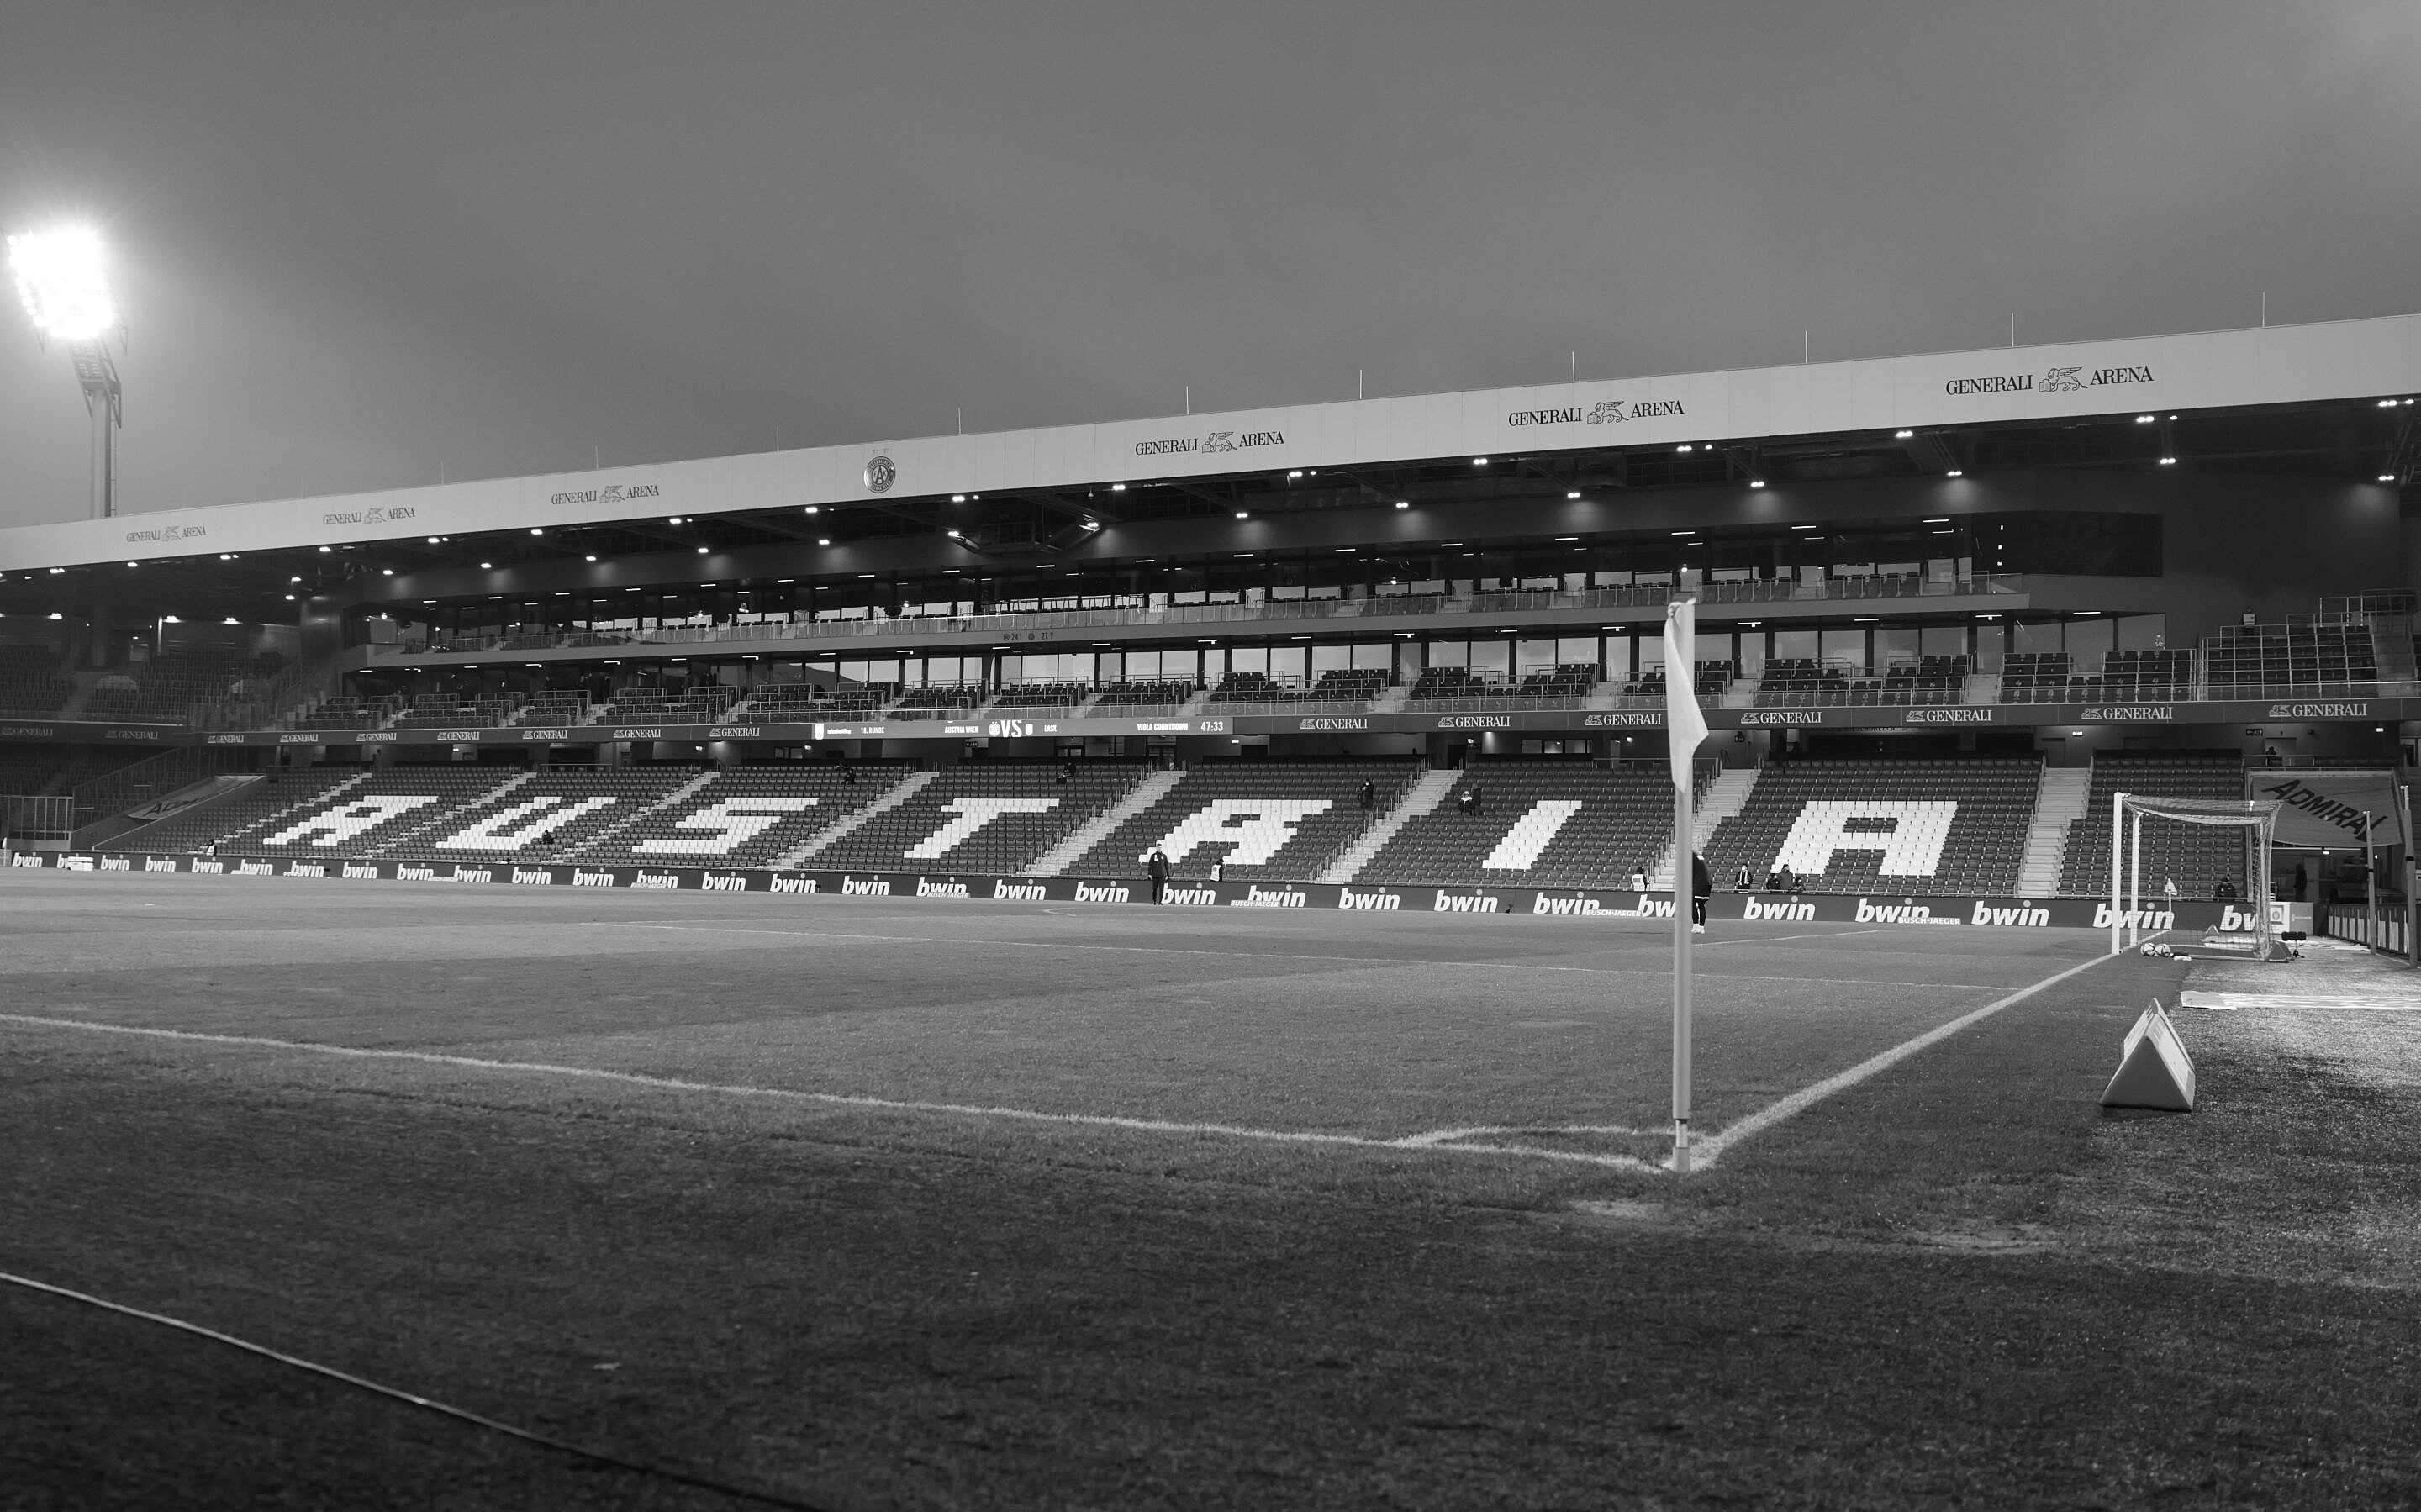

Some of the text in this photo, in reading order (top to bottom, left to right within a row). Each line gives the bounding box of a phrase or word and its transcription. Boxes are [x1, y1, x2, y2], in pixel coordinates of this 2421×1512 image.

[1946, 366, 2155, 395] GENERALI ARENA
[1508, 400, 1685, 426] GENERALI ARENA
[1135, 431, 1284, 456] GENERALI ARENA
[551, 485, 659, 504] GENERALI ARENA
[323, 507, 415, 525] GENERALI ARENA
[126, 526, 207, 543] GENERALI ARENA
[1759, 711, 1822, 724] GENERALI
[1927, 709, 1992, 721] GENERALI
[2103, 707, 2173, 719] GENERALI
[2292, 703, 2367, 717] GENERALI
[1000, 719, 1022, 738] VS
[1137, 723, 1153, 731] VIOLA
[1200, 721, 1223, 731] 47:33
[1316, 719, 1368, 729] GENERALI
[1455, 716, 1511, 728] GENERALI
[1604, 714, 1662, 725] GENERALI
[13, 728, 53, 736] GENERALI
[118, 731, 159, 740] GENERALI
[215, 735, 244, 743] GENERALI
[288, 734, 319, 742] GENERALI
[366, 733, 397, 741] GENERALI
[447, 732, 480, 740] GENERALI
[533, 730, 567, 740] GENERALI
[625, 729, 662, 738] GENERALI
[721, 727, 760, 737] GENERALI
[2260, 779, 2388, 841] ADMIRAL
[12, 851, 43, 867] bwin
[100, 854, 130, 871] bwin
[145, 856, 177, 872] bwin
[191, 856, 224, 874] bwin
[239, 858, 273, 875] bwin
[291, 859, 324, 877] bwin
[342, 861, 378, 878] bwin
[396, 862, 434, 881] bwin
[454, 864, 492, 882] bwin
[512, 866, 552, 885] bwin
[572, 867, 614, 887] bwin
[636, 869, 679, 888] bwin
[701, 871, 746, 891] bwin
[769, 872, 818, 893] bwin
[841, 875, 890, 896] bwin
[915, 877, 968, 898] bwin
[994, 878, 1047, 900] bwin
[1074, 880, 1130, 903] bwin
[1161, 882, 1216, 905] bwin
[1247, 884, 1306, 907] bwin
[1338, 887, 1400, 910] bwin
[1433, 888, 1499, 913] bwin
[1532, 891, 1600, 915] bwin
[1638, 893, 1675, 918] bw
[1743, 895, 1816, 921] bwin
[1854, 897, 1931, 923] bwin
[1897, 916, 1961, 925] BUSCH-JAEGER
[1971, 899, 2050, 927] bwin
